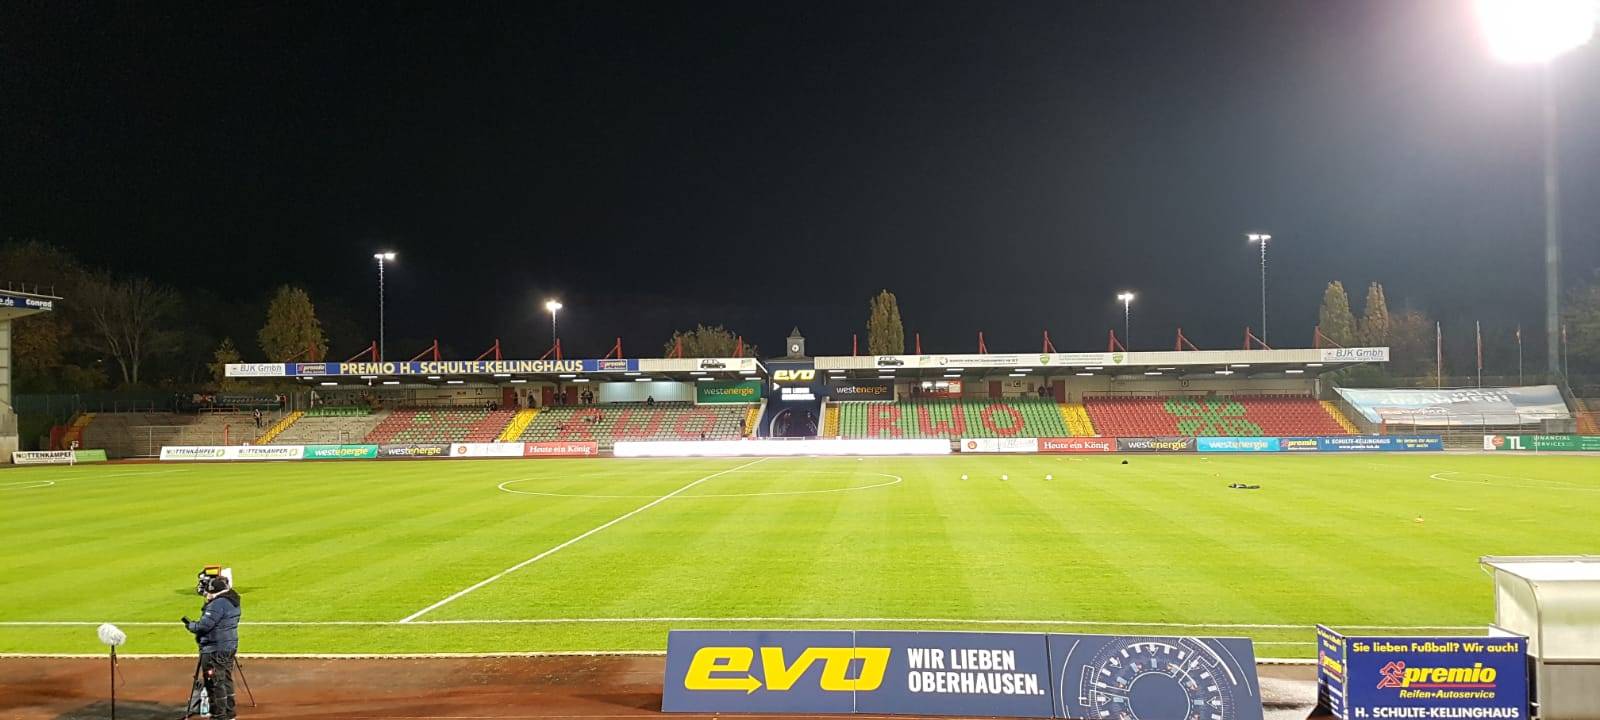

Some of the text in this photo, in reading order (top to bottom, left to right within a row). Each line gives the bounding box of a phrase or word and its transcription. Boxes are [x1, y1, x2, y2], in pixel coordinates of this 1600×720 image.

[340, 360, 584, 374] PREMIO H. SCHULTE-KELLINGHAUS
[773, 370, 815, 381] evo
[703, 386, 754, 396] westenergie
[836, 385, 888, 395] westenergie
[867, 402, 1025, 438] RWO
[1044, 440, 1109, 451] Heute ein König
[1128, 440, 1187, 451] westenergie
[1209, 440, 1268, 450] westenergie
[315, 447, 369, 456] westenergie
[388, 446, 442, 456] westenergie
[1353, 642, 1519, 653] Sie lieben Fußball? Wir auch!
[907, 647, 1015, 671] WIR LIEBEN
[684, 646, 891, 694] evo
[1402, 662, 1497, 687] premio
[908, 671, 1045, 695] OBERHAUSEN.
[1354, 707, 1519, 719] H. SCHULTE-KELLINGHAUS
